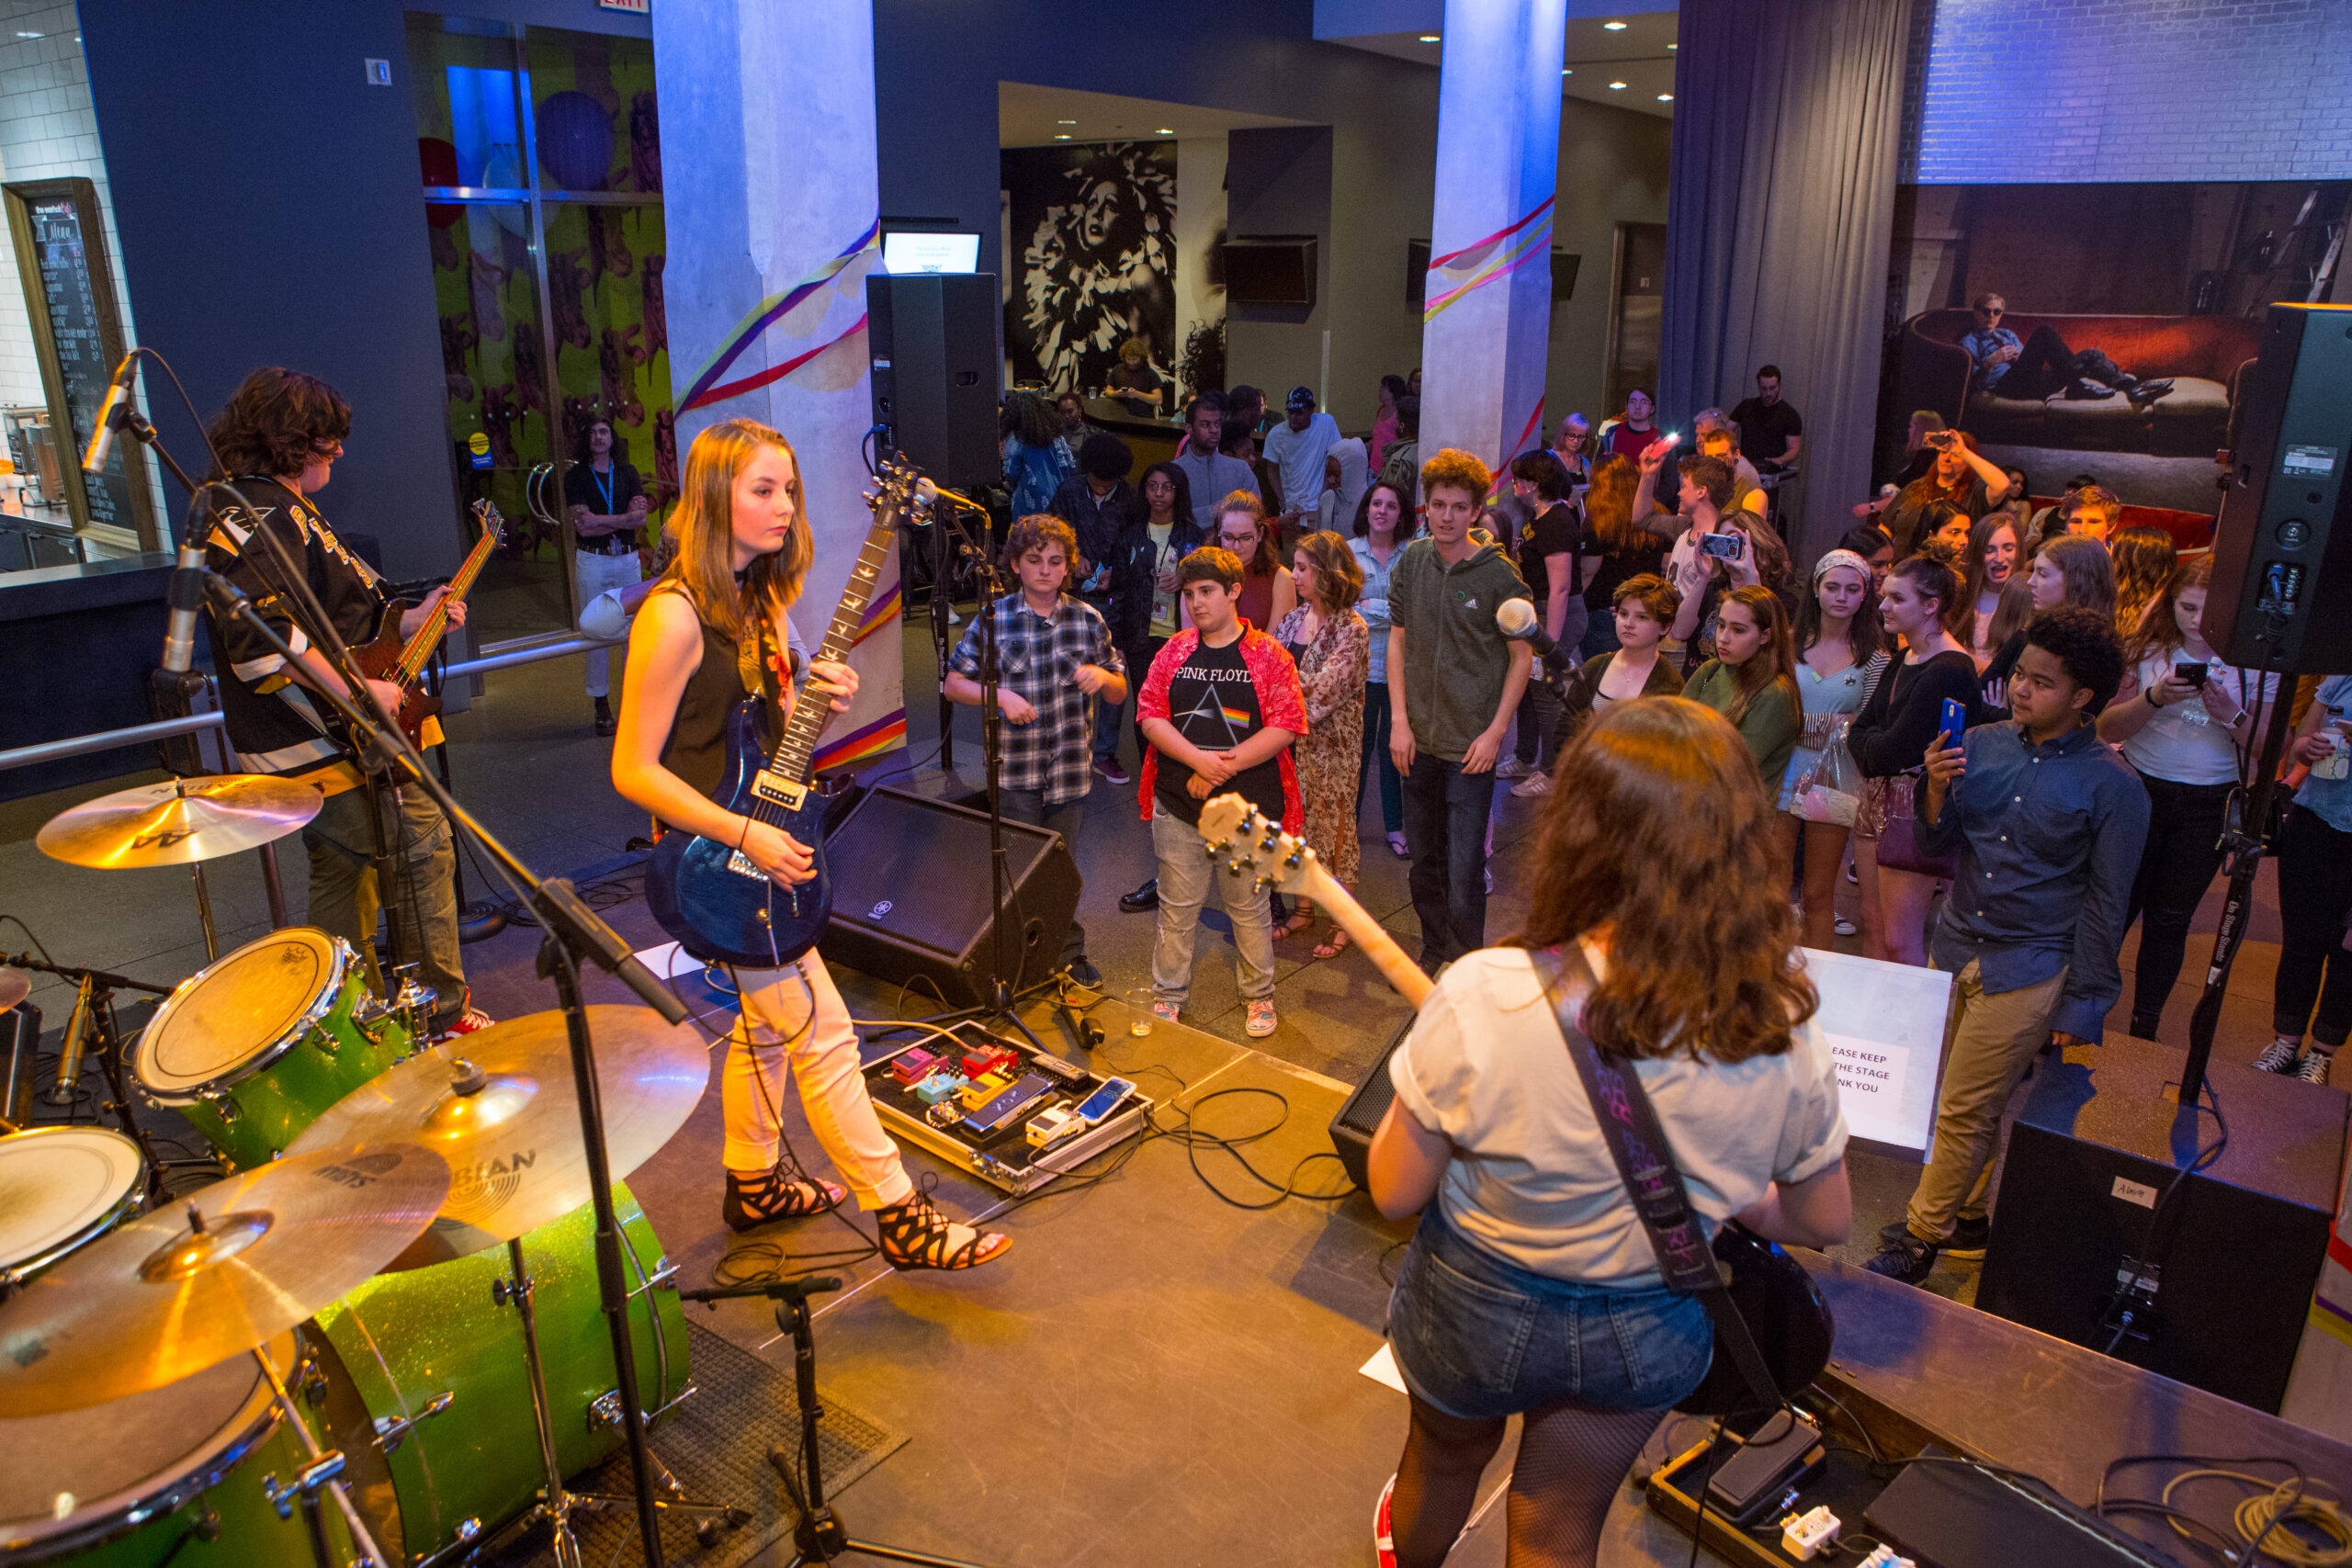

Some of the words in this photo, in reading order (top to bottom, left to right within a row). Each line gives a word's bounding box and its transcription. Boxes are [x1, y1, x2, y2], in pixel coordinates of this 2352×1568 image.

[1176, 667, 1208, 681] PINK
[1209, 669, 1252, 683] FLOYD
[1832, 1047, 1858, 1058] EASE
[1860, 1053, 1886, 1063] KEEP
[1834, 1062, 1854, 1073] THE
[1856, 1066, 1890, 1079] STAGE
[1855, 1081, 1879, 1093] YOU
[454, 1149, 537, 1185] BIAN
